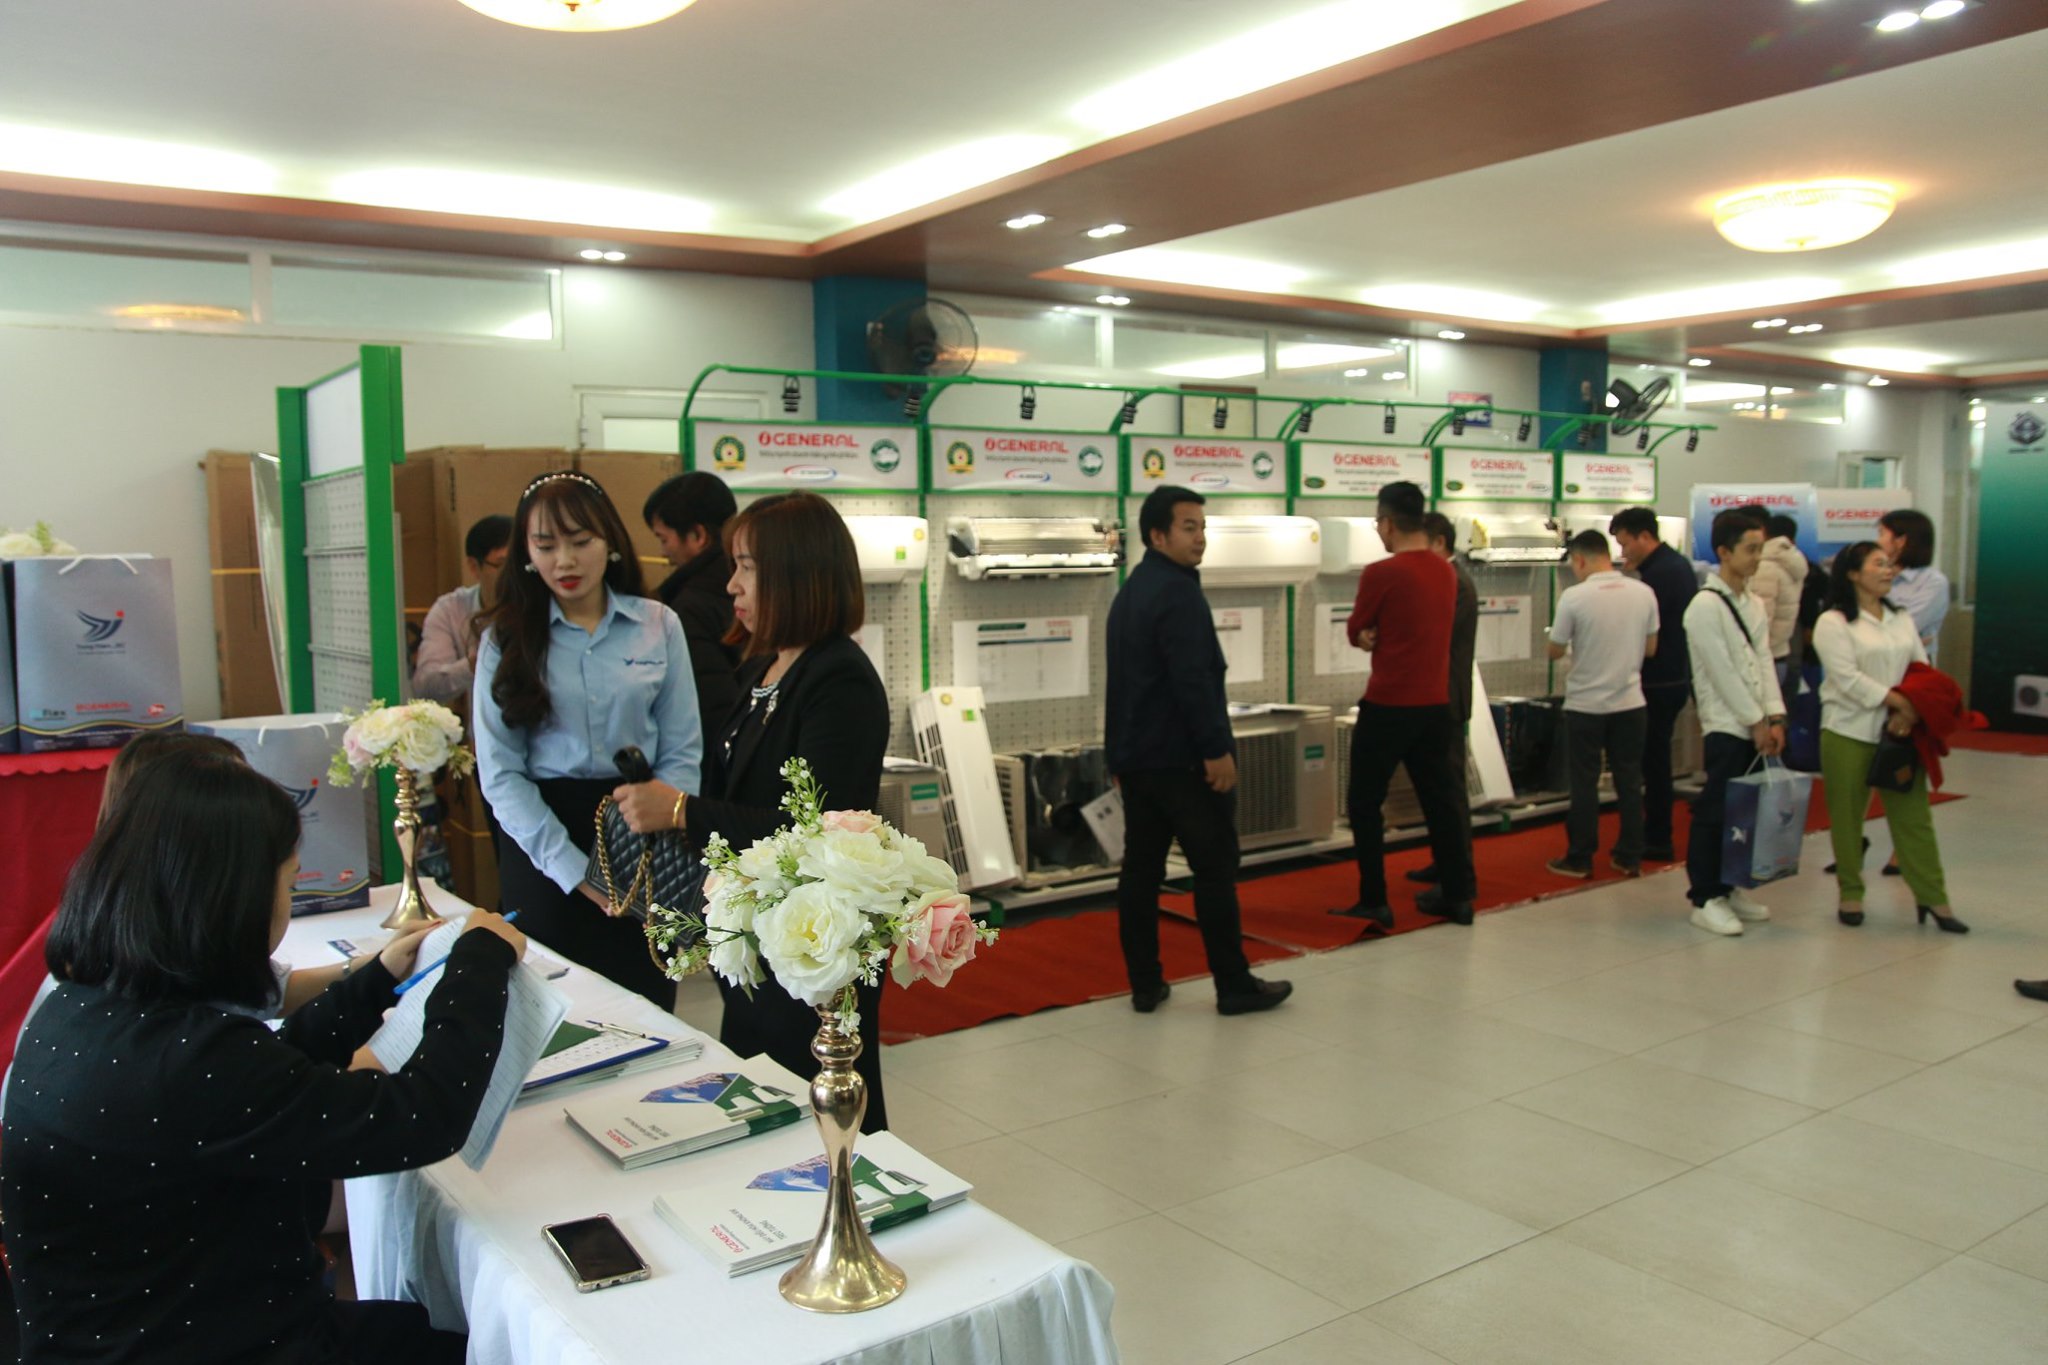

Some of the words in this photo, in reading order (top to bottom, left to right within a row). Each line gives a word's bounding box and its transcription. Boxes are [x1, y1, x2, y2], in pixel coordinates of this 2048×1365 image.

[773, 432, 859, 449] GENERAL
[998, 438, 1070, 454] GENERAL
[1185, 446, 1244, 459] GENERAL
[1345, 455, 1401, 468] GENERAL
[1480, 458, 1528, 472] GENERAL
[711, 1225, 739, 1249] GENERAL
